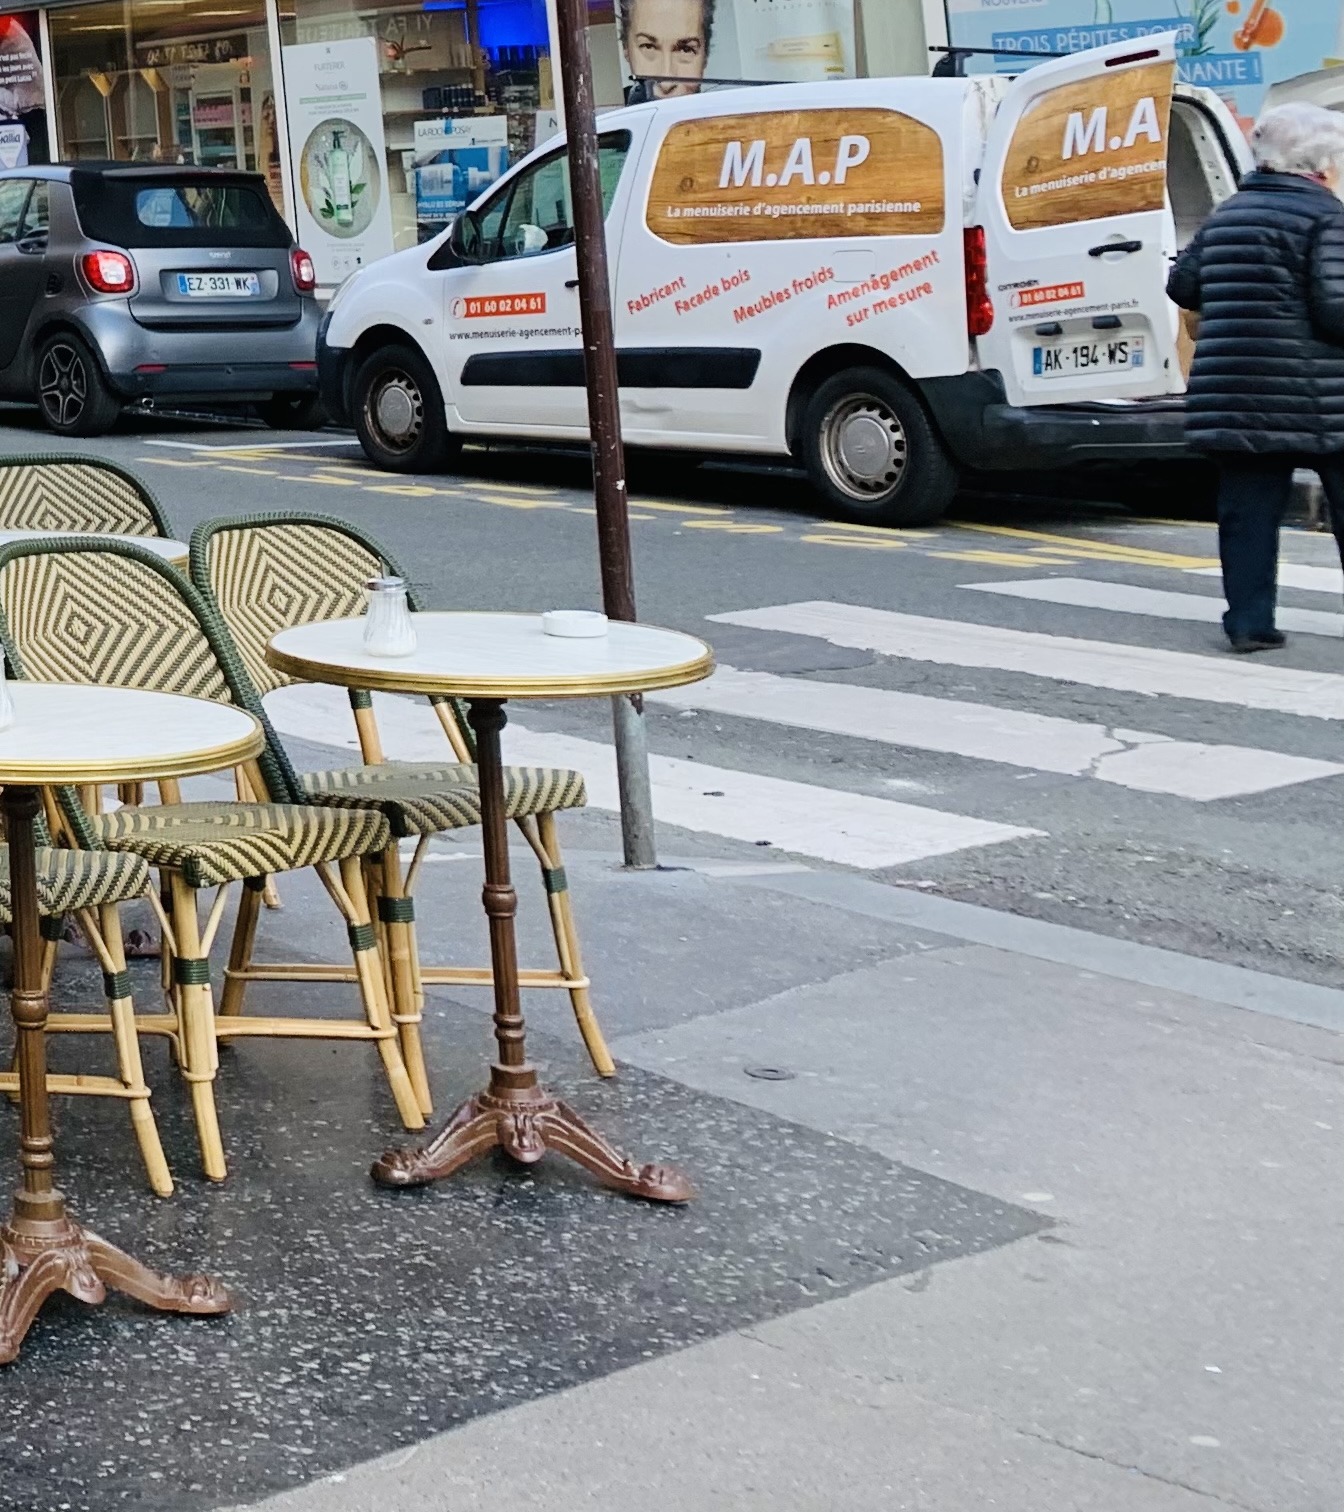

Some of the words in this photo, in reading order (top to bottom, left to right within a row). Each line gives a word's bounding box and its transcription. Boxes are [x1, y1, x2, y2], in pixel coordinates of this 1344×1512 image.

[995, 35, 1051, 52] TROIS
[1056, 27, 1129, 54] PÉPITES
[1176, 59, 1248, 82] NANTE
[1063, 97, 1162, 160] M.A
[719, 135, 871, 188] M.A.P
[1015, 186, 1029, 198] La
[1030, 171, 1096, 193] menuiserie
[1098, 159, 1167, 180] d'agencem
[667, 205, 681, 217] La
[683, 203, 751, 217] menuiserie
[753, 201, 844, 218] d'agencement
[847, 200, 921, 216] parisienne
[627, 276, 687, 315] Fabricant
[720, 269, 751, 292] bois
[733, 290, 792, 324] Meubles
[792, 266, 835, 295] froids
[470, 302, 481, 313] 01
[484, 300, 497, 312] 60
[499, 299, 512, 311] 02
[514, 298, 527, 310] 04
[530, 297, 542, 309] 61
[846, 307, 870, 327] sur
[872, 282, 933, 315] mesure
[449, 326, 583, 340] www.menuiserie-agencement-p
